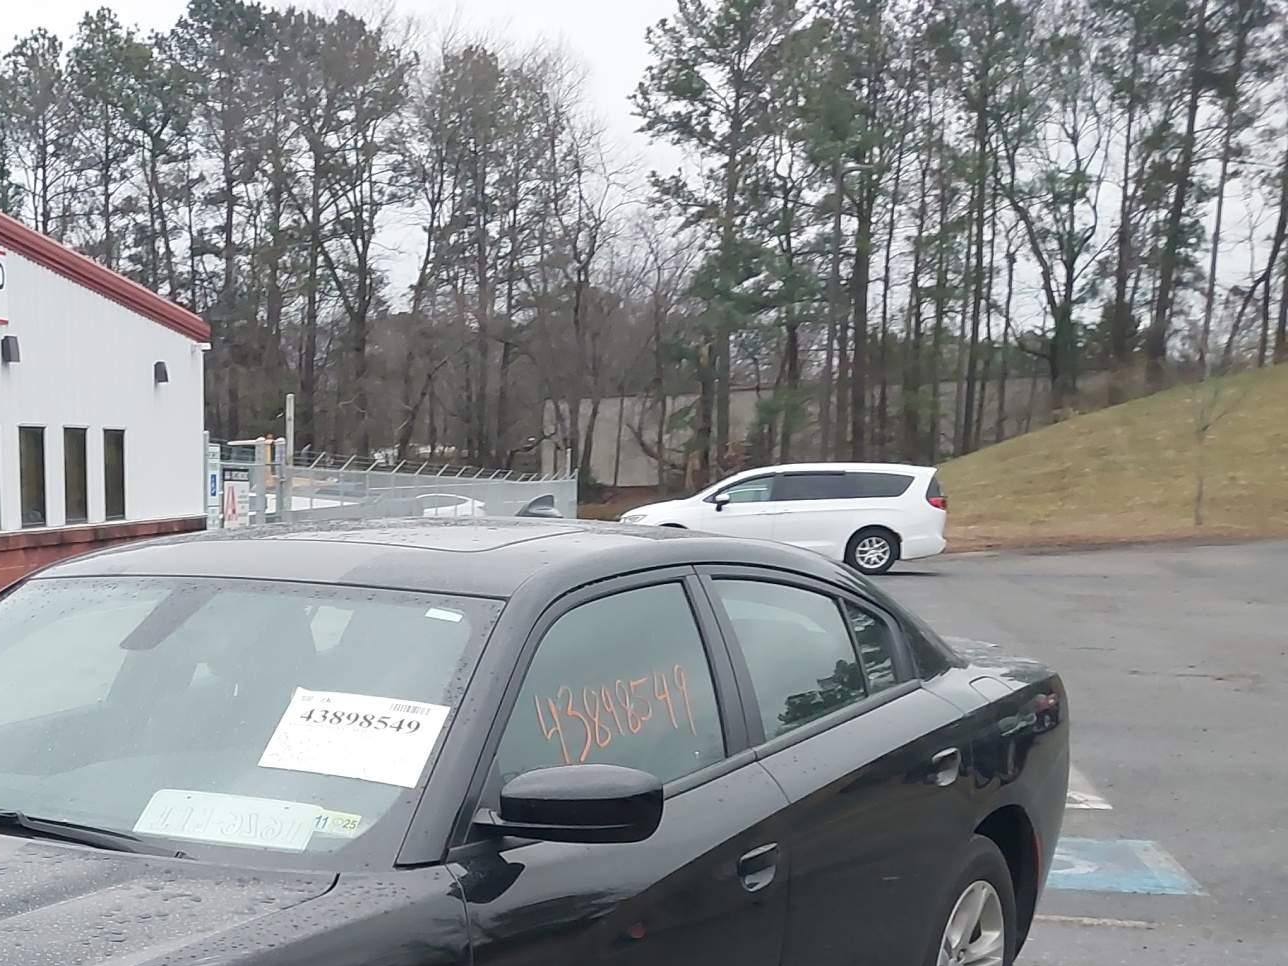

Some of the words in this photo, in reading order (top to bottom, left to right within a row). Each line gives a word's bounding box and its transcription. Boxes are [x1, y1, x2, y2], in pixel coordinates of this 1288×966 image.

[300, 708, 421, 734] 43898549
[535, 664, 697, 764] 43898549
[315, 815, 328, 829] 11
[343, 819, 358, 830] 25
